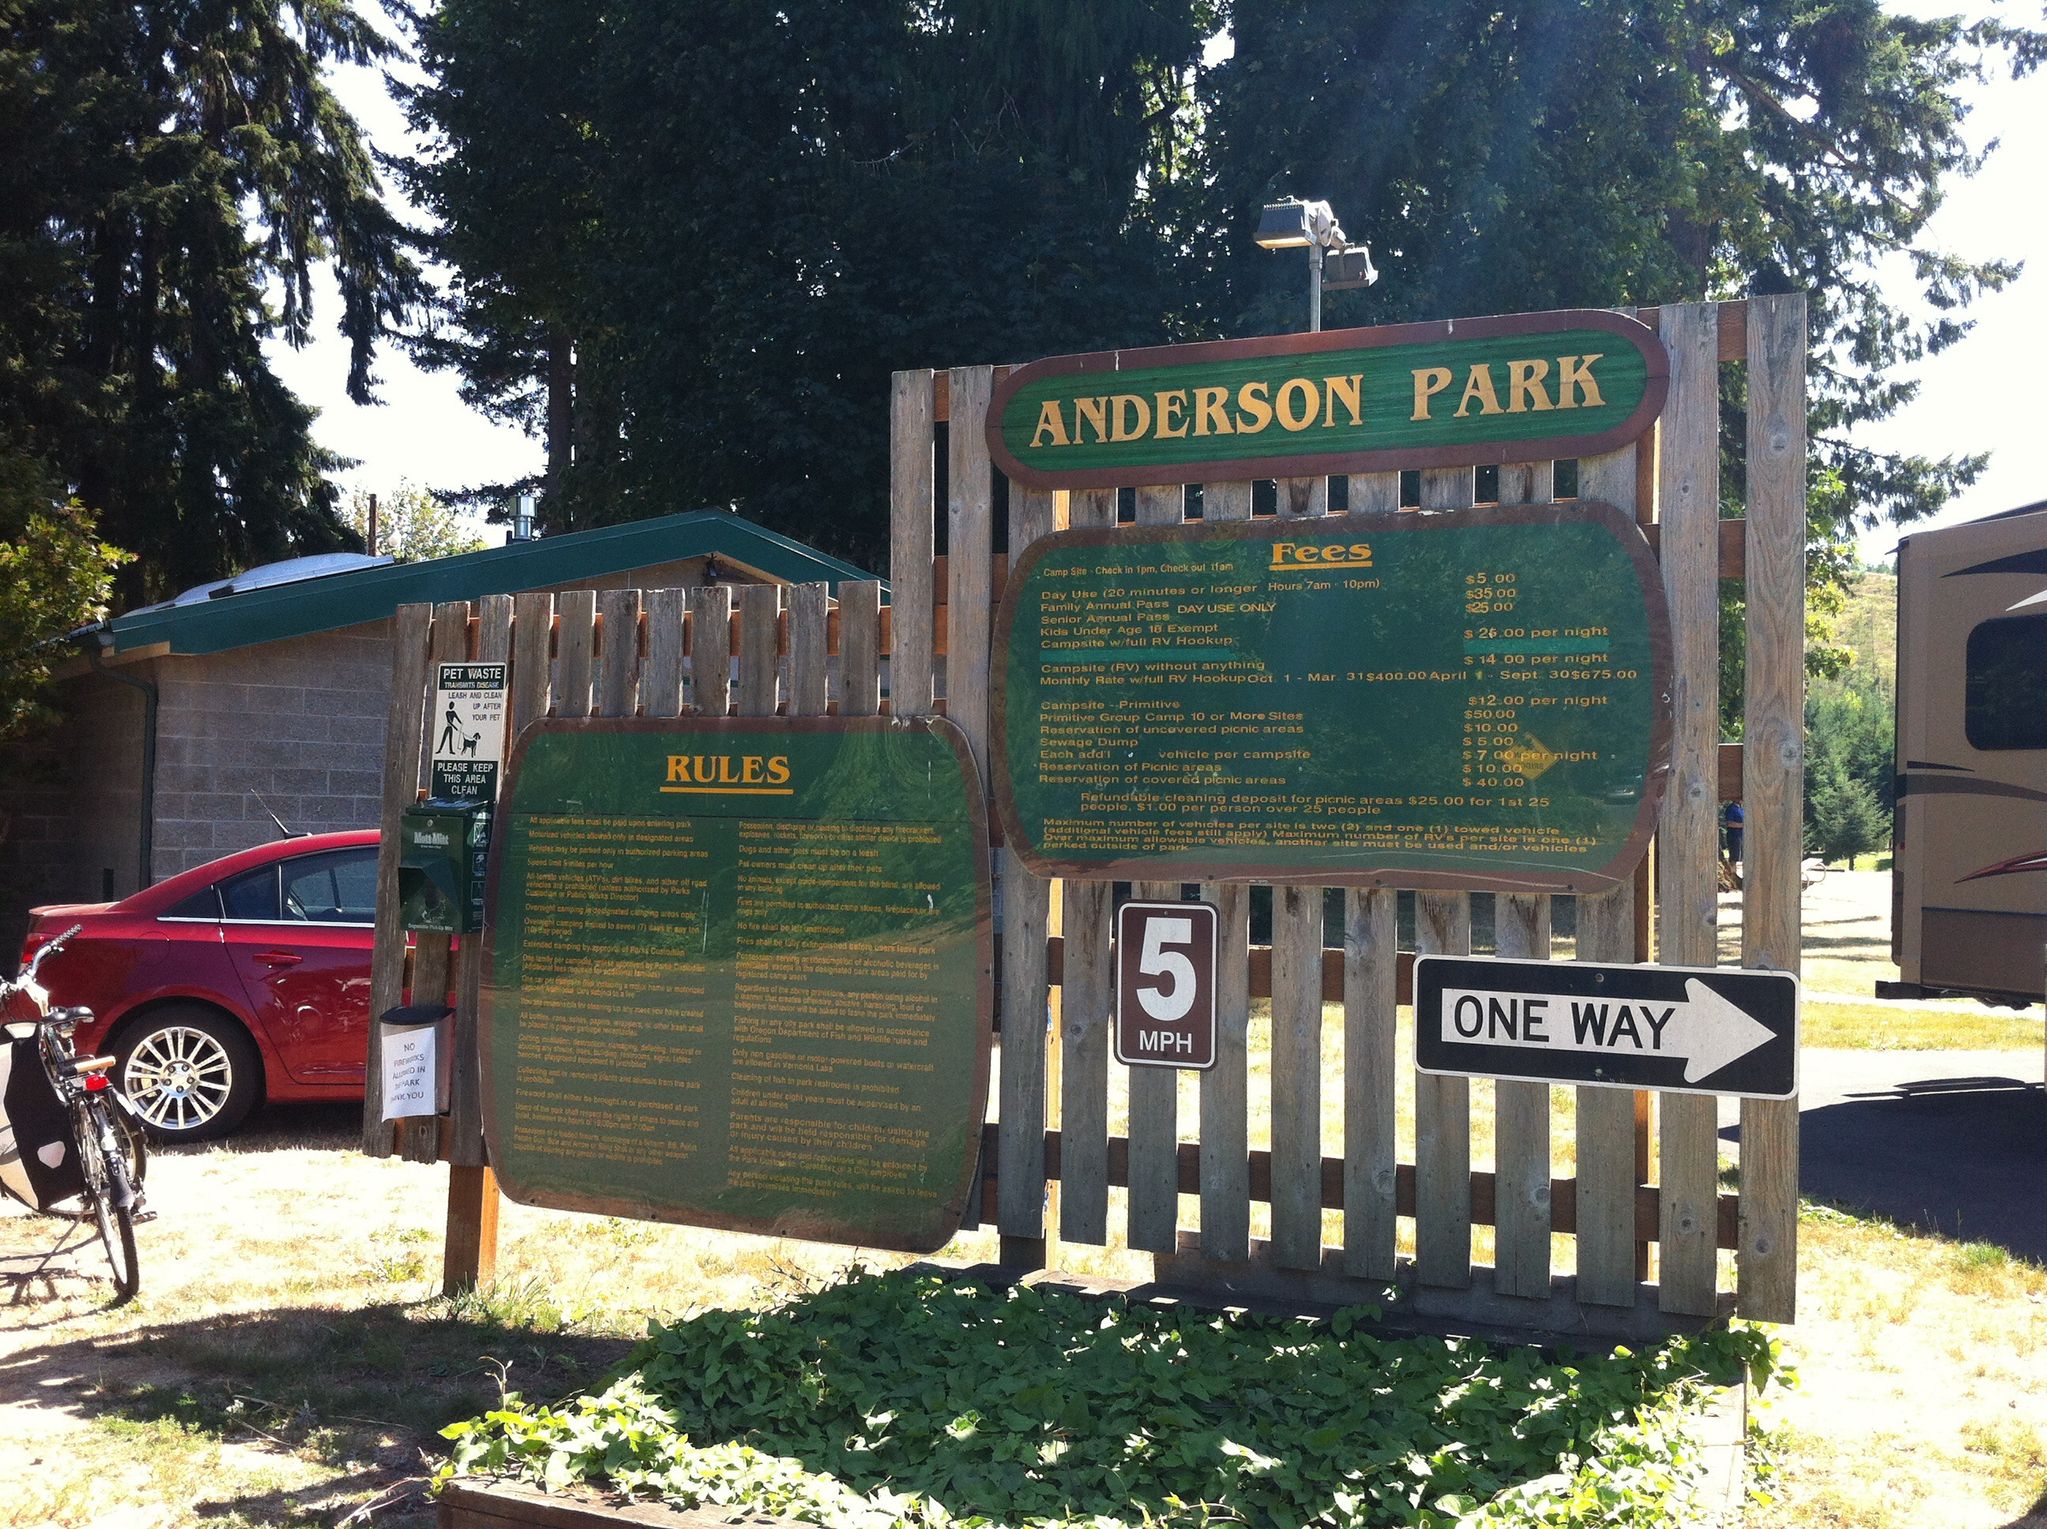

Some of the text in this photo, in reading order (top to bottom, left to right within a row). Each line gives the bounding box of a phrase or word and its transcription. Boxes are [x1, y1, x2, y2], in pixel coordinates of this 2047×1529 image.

[1030, 354, 1605, 448] ANDERSON PARK
[1272, 543, 1371, 563] Fees
[1044, 568, 1068, 578] Camp
[1095, 566, 1122, 575] Check
[1125, 566, 1133, 574] in
[1161, 563, 1188, 573] Check
[1191, 564, 1206, 572] out
[1041, 591, 1067, 601] Day
[1130, 588, 1185, 596] minutes
[1191, 587, 1204, 595] or
[1210, 585, 1257, 596] longer
[1268, 583, 1302, 591] Hours
[1306, 581, 1331, 590] 7am
[1041, 600, 1276, 614] Family Annual Pass DAY USE ONLY
[1041, 613, 1170, 624] Senior Annual Pass
[1040, 628, 1068, 636] Kids
[1074, 627, 1112, 636] Under
[1118, 626, 1142, 635] Age
[1168, 624, 1218, 633] Exempt
[1531, 627, 1608, 638] per night
[1041, 640, 1105, 649] Campsite
[1110, 639, 1146, 647] w/full
[1177, 637, 1232, 646] Hookup
[1531, 653, 1608, 665] per night
[1041, 661, 1265, 673] Campsite (RV) without anything
[443, 668, 501, 679] PET WASTE
[1040, 677, 1090, 686] Monthly
[1096, 676, 1125, 685] Rate
[1130, 675, 1163, 684] w/full
[1169, 675, 1186, 683] RV
[1041, 702, 1104, 710] Campsite
[1531, 697, 1558, 707] per
[1565, 696, 1608, 707] night
[1040, 714, 1094, 722] Primitive
[1100, 713, 1139, 722] Group
[1145, 713, 1184, 722] Camp
[1192, 712, 1204, 720] 10
[1230, 712, 1265, 720] More
[1268, 711, 1303, 720] Sites
[1040, 726, 1120, 734] Reservation
[1126, 725, 1138, 733] of
[1143, 725, 1216, 734] uncovered
[1221, 725, 1259, 734] picnic
[1041, 738, 1138, 747] Sewage Dump
[1159, 750, 1209, 758] vehicle
[1214, 751, 1238, 760] per
[1244, 750, 1311, 760] campsite
[1520, 751, 1598, 761] per night
[438, 763, 493, 772] PLEASE KEEP
[666, 756, 790, 783] RULES
[1040, 762, 1222, 772] Reservation of Picnic areas
[444, 774, 486, 783] THIS AREA
[1040, 775, 1119, 783] Reservation
[1125, 775, 1138, 783] of
[1142, 776, 1200, 784] covered
[1204, 776, 1242, 785] picnic
[451, 785, 477, 794] CLEAN
[1081, 793, 1160, 802] Refundable
[1165, 794, 1226, 804] cleaning
[1232, 794, 1287, 804] deposit
[1291, 794, 1311, 803] for
[1315, 795, 1355, 805] picnic
[1360, 797, 1402, 806] areas
[1470, 797, 1492, 806] for
[1529, 798, 1550, 807] 25
[1182, 804, 1204, 812] per
[1211, 804, 1260, 813] person
[1304, 805, 1321, 813] 25
[1328, 806, 1380, 816] people
[1044, 818, 1104, 826] Maximum
[1180, 820, 1233, 828] vehicles
[1137, 917, 1196, 1021] 5
[1454, 995, 1675, 1050] ONE WAY
[404, 1043, 415, 1051] NO
[1139, 1030, 1192, 1053] MPH
